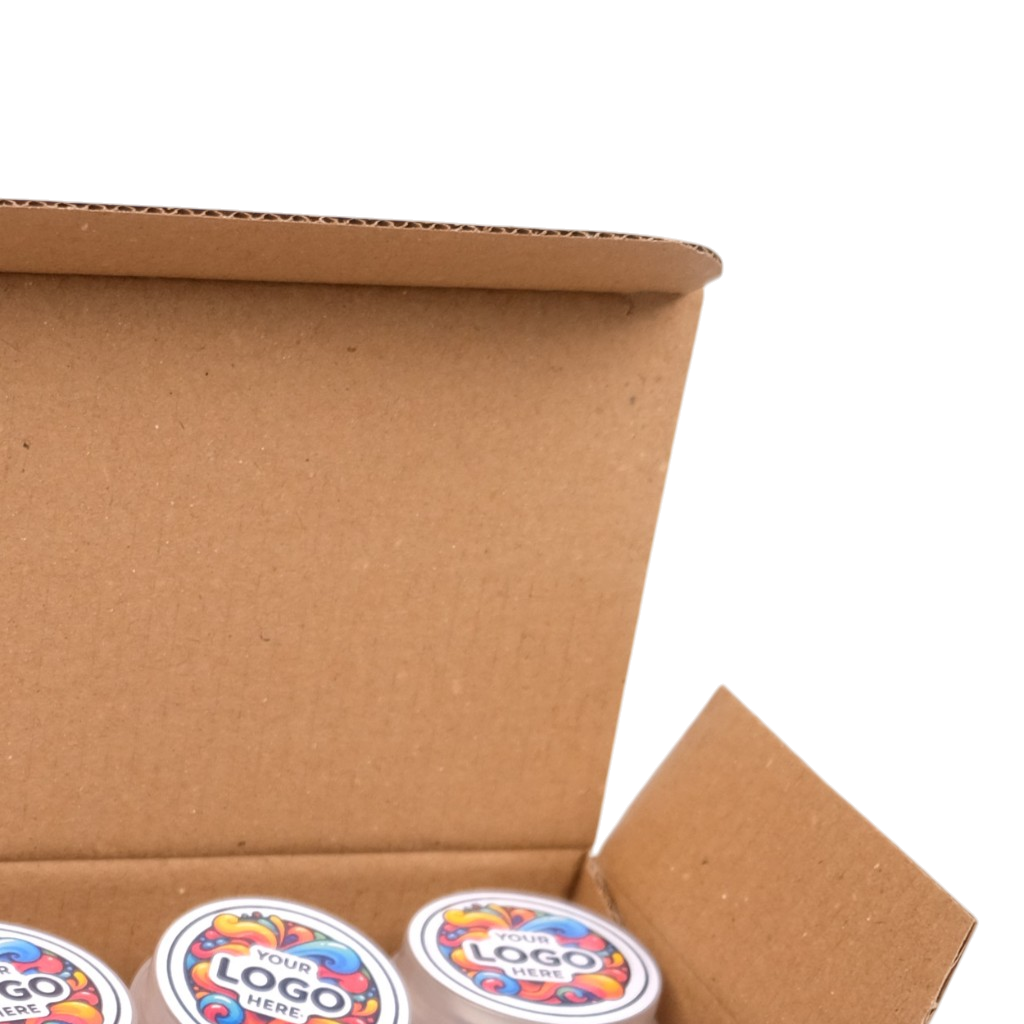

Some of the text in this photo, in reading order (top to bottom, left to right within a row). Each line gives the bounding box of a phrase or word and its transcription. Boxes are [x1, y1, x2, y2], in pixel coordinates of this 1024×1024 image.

[494, 932, 550, 945] YOUR
[256, 949, 312, 975] YOUR
[470, 942, 596, 969] LOGO
[216, 957, 345, 1012] LOGO
[511, 967, 564, 979] HERE
[247, 995, 301, 1019] HERE
